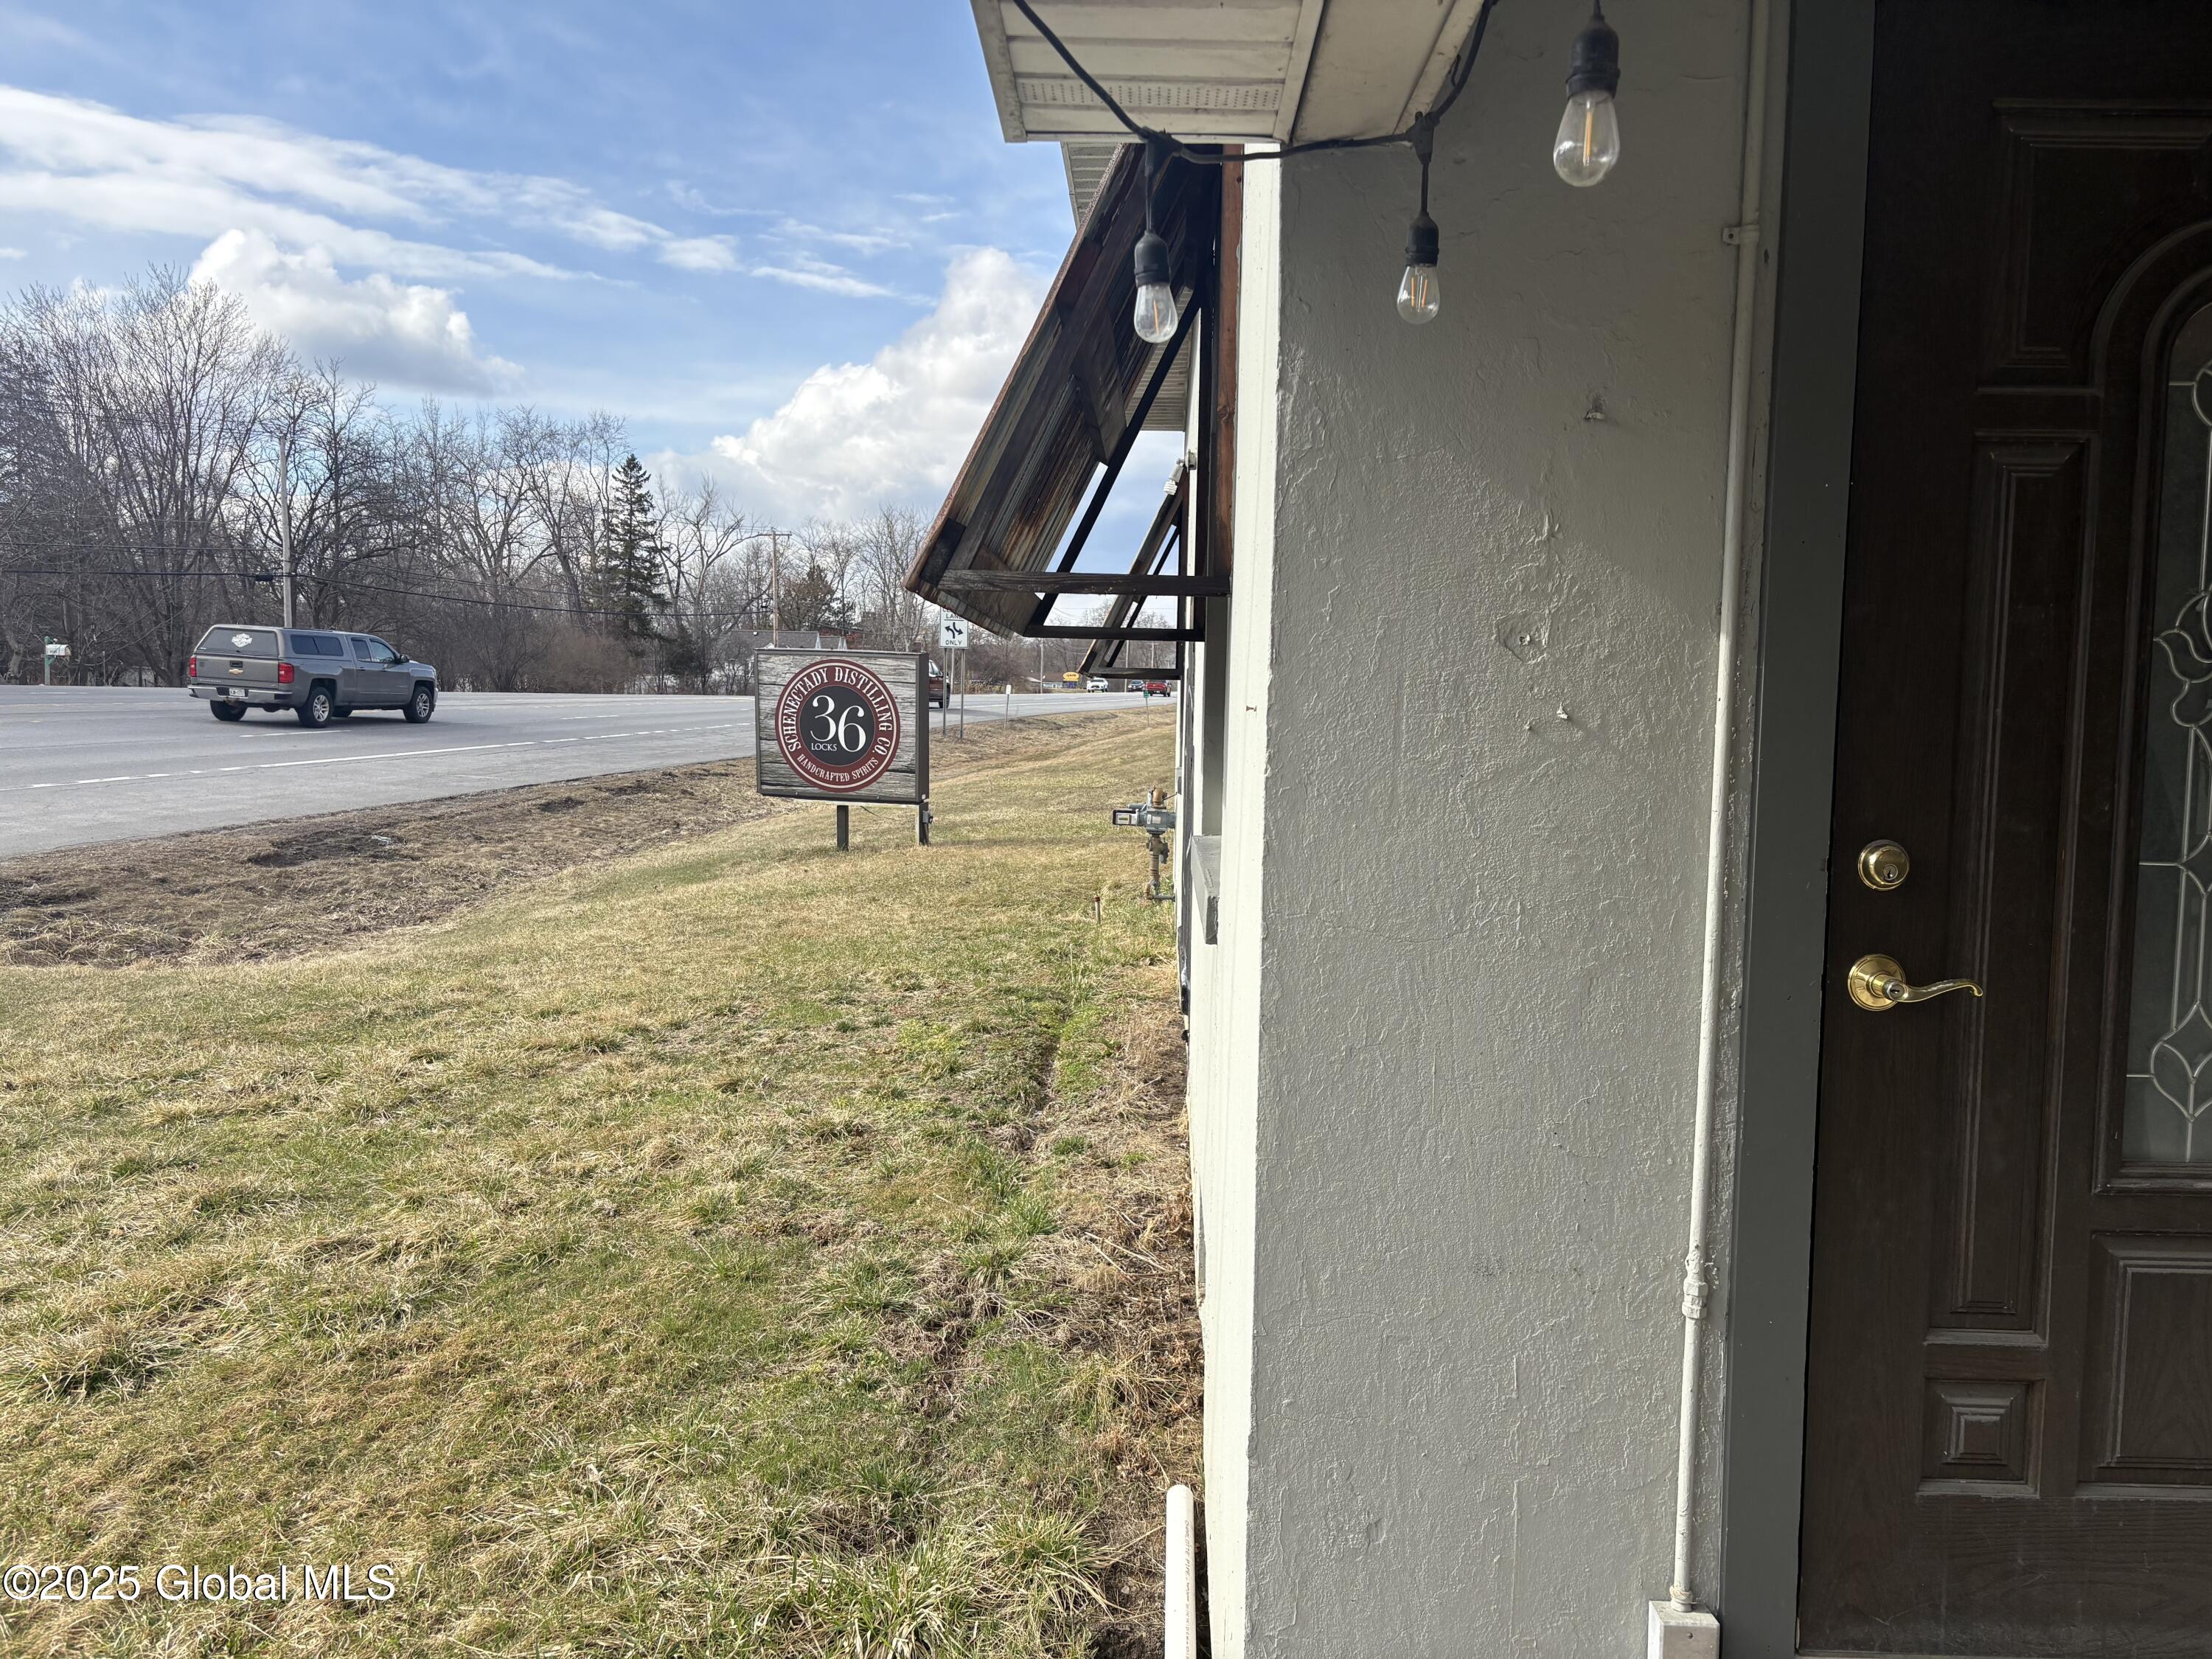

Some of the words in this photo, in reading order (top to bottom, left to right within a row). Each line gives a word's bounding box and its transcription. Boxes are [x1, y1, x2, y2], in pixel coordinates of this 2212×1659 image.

[782, 667, 829, 752] SCHENECTADY
[835, 667, 892, 731] DISTILLING
[872, 737, 891, 756] CO.
[810, 695, 866, 752] 36
[811, 742, 837, 751] LOCKS
[797, 754, 850, 782] HANDCRAFTED
[852, 757, 879, 782] SPIRITS
